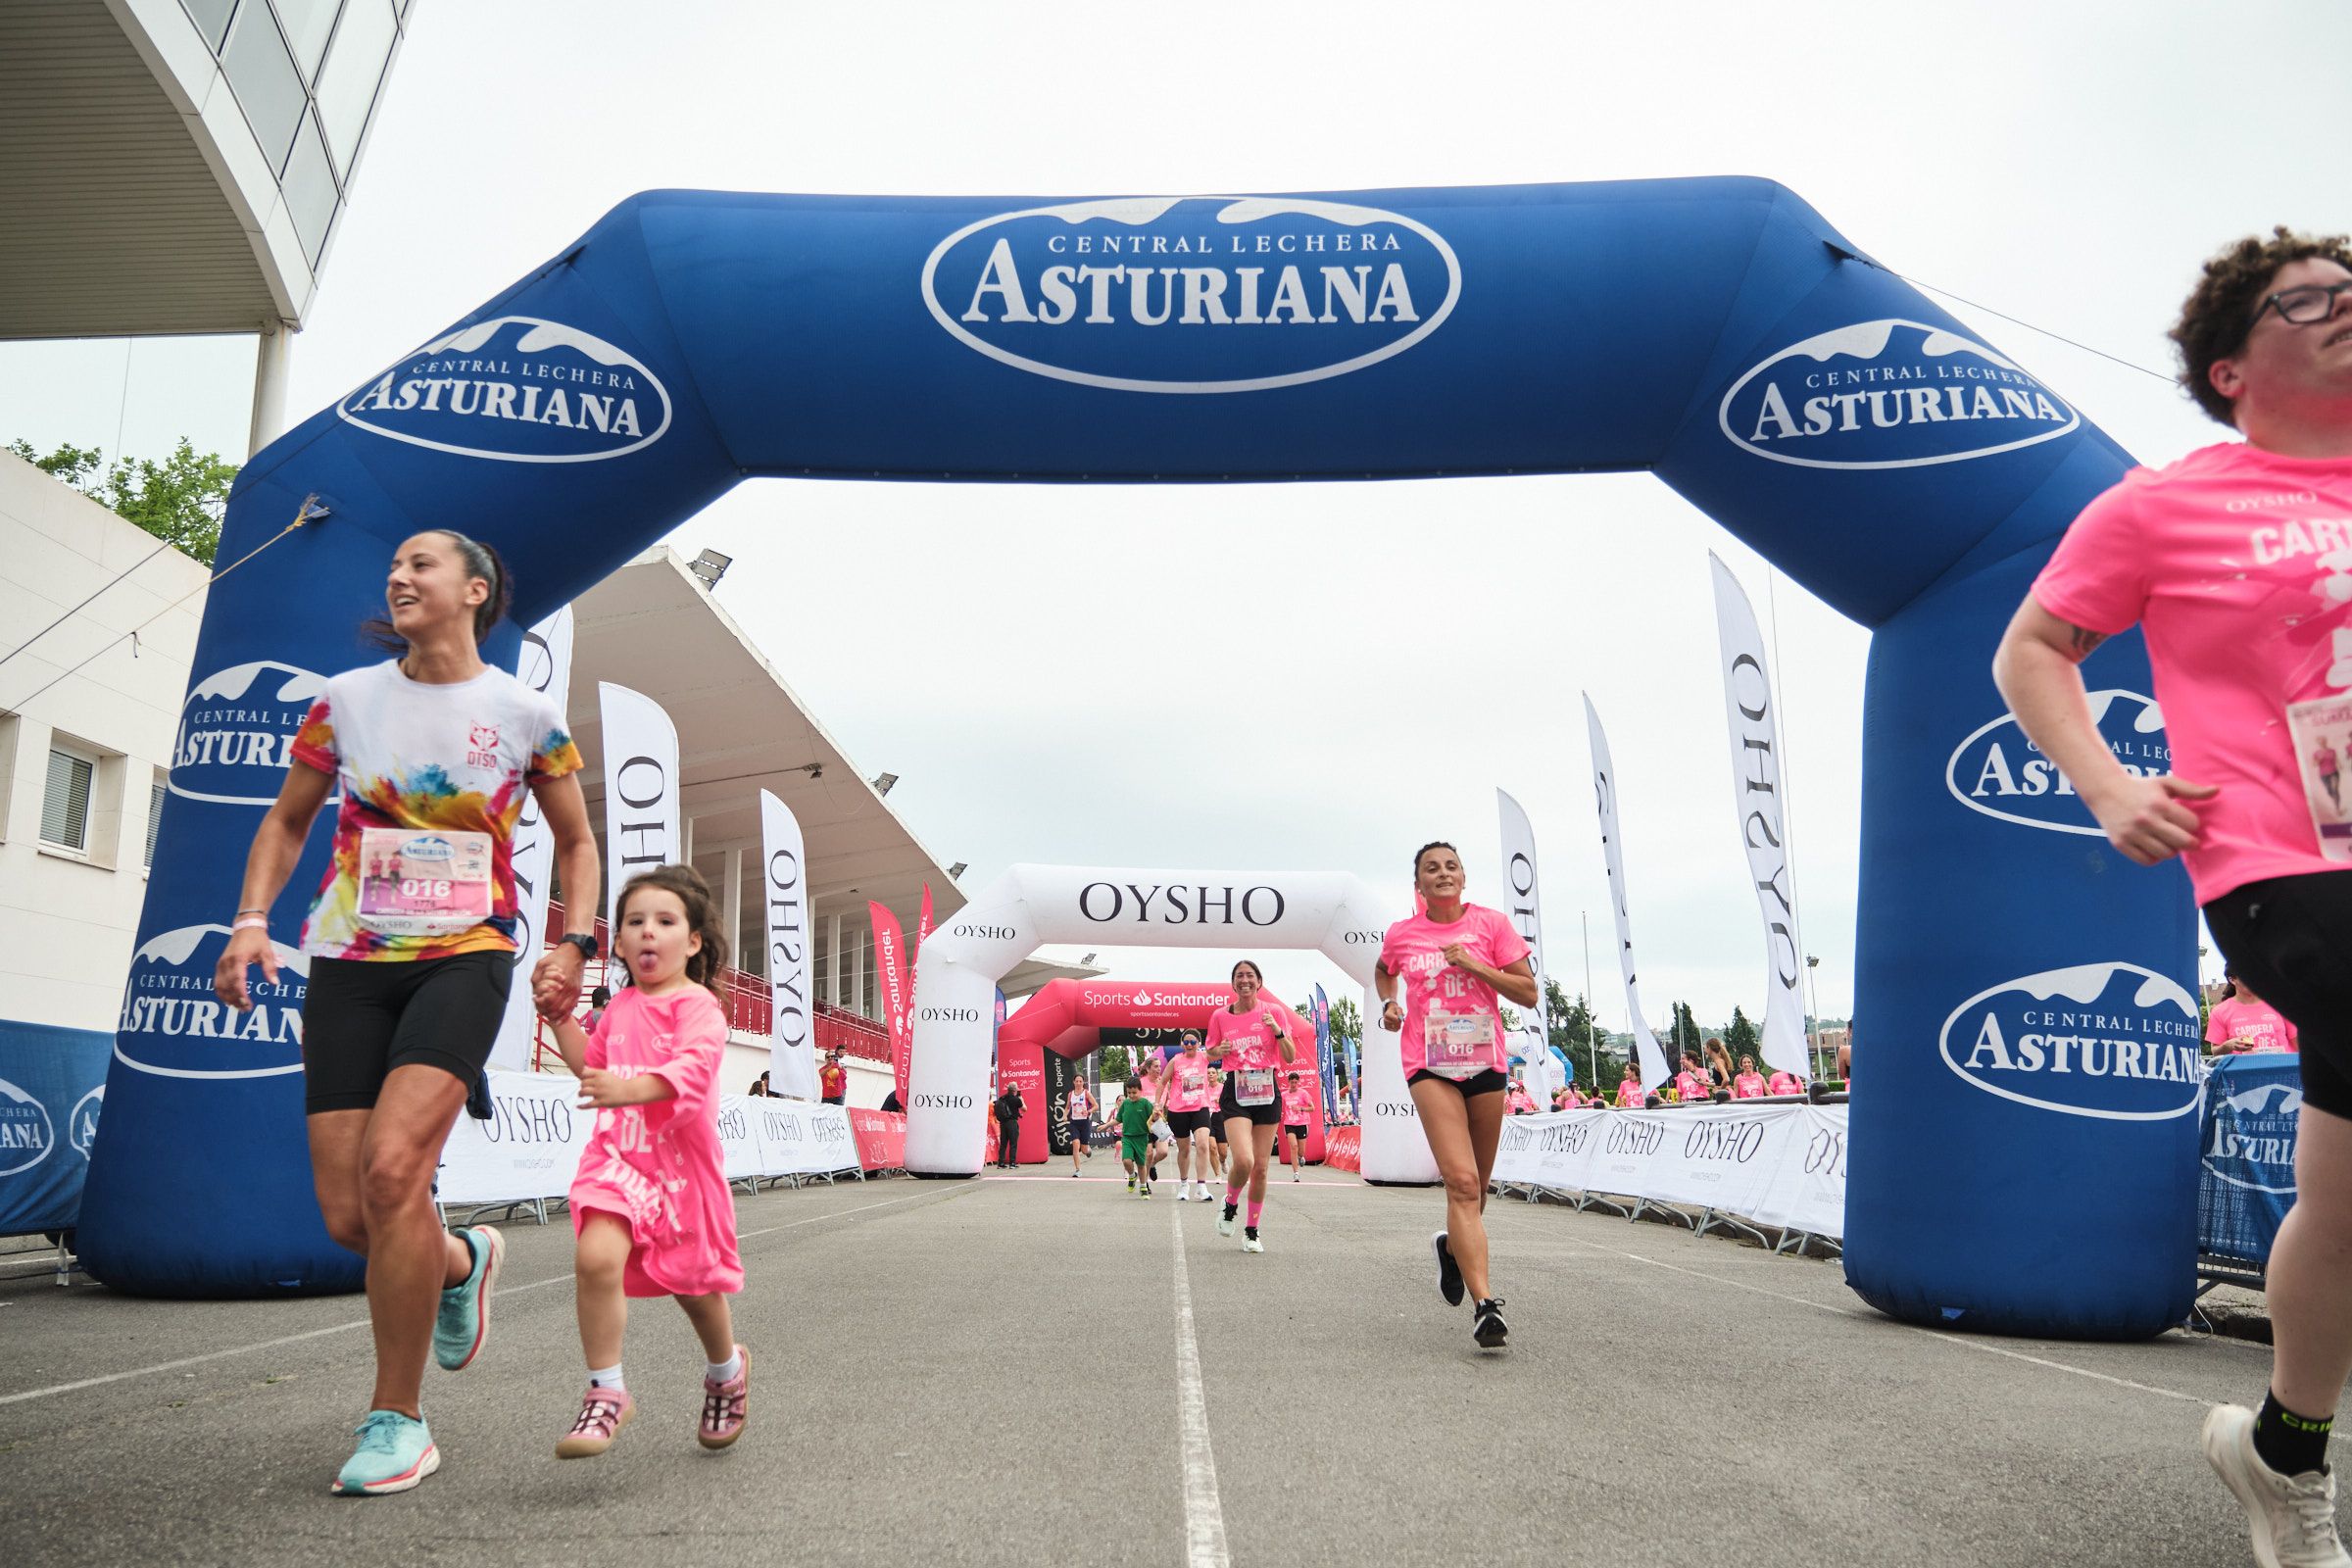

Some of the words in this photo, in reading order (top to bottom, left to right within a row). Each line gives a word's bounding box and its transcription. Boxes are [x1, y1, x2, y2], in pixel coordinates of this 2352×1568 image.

[1048, 234, 1213, 255] CENTRAL
[1231, 232, 1402, 253] LECHERA
[960, 237, 1421, 325] ASTURIANA
[412, 359, 510, 375] CENTRAL
[522, 363, 636, 391] LECHERA
[1806, 366, 1927, 389] CENTRAL
[1938, 365, 2036, 389] LECHERA
[350, 370, 643, 438] ASTURIANA
[1749, 382, 2067, 442] ASTURIANA
[2227, 491, 2317, 514] OYSHO
[194, 710, 270, 724] CENTRAL
[172, 717, 297, 768] ASTURI
[402, 879, 451, 898] 016
[1079, 882, 1285, 926] OYSHO
[954, 925, 1015, 941] OYSHO
[140, 975, 216, 991] CENTRAL
[1084, 991, 1130, 1007] Sports
[1153, 993, 1230, 1006] Santander
[119, 977, 304, 1045] ASTURIAN
[921, 1007, 979, 1022] OYSHO
[2023, 1010, 2132, 1031] CENTRAL
[2234, 1024, 2275, 1037] CARRERA
[1231, 1035, 1262, 1051] ARRERA
[1448, 1044, 1474, 1054] 016
[1964, 1011, 2200, 1085] ASTURIANA
[1009, 1059, 1031, 1068] Sports
[1055, 1057, 1064, 1087] Deporte
[914, 1094, 972, 1109] OYSHO
[763, 1110, 803, 1142] OYSHO
[1606, 1121, 1665, 1155] OYSHO
[1685, 1120, 1764, 1163] OYSHO
